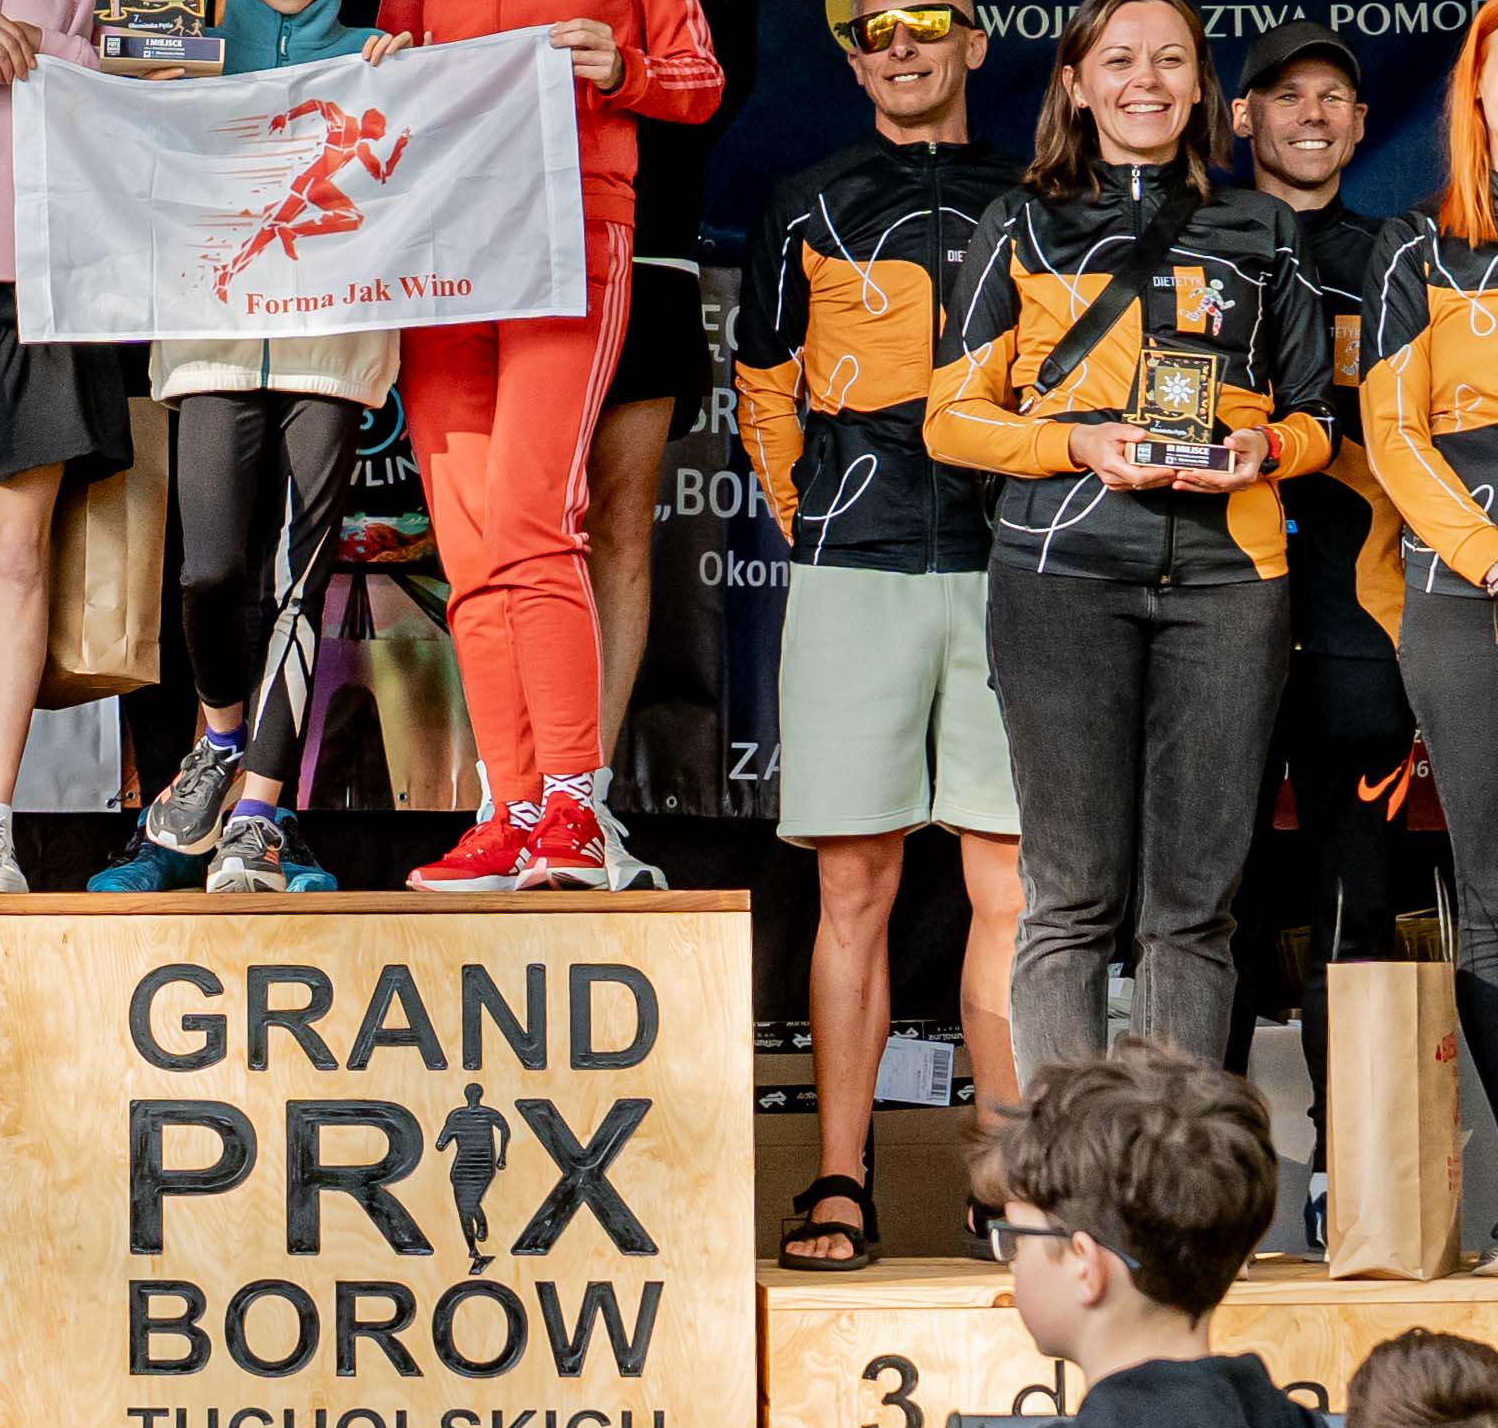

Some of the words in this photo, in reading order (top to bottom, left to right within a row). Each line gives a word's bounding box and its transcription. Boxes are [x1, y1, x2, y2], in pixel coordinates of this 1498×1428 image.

[245, 292, 334, 315] Forma
[343, 278, 391, 305] Jak
[399, 273, 472, 300] Wino
[129, 962, 661, 1073] GRAND
[129, 1259, 663, 1379] BORÓW
